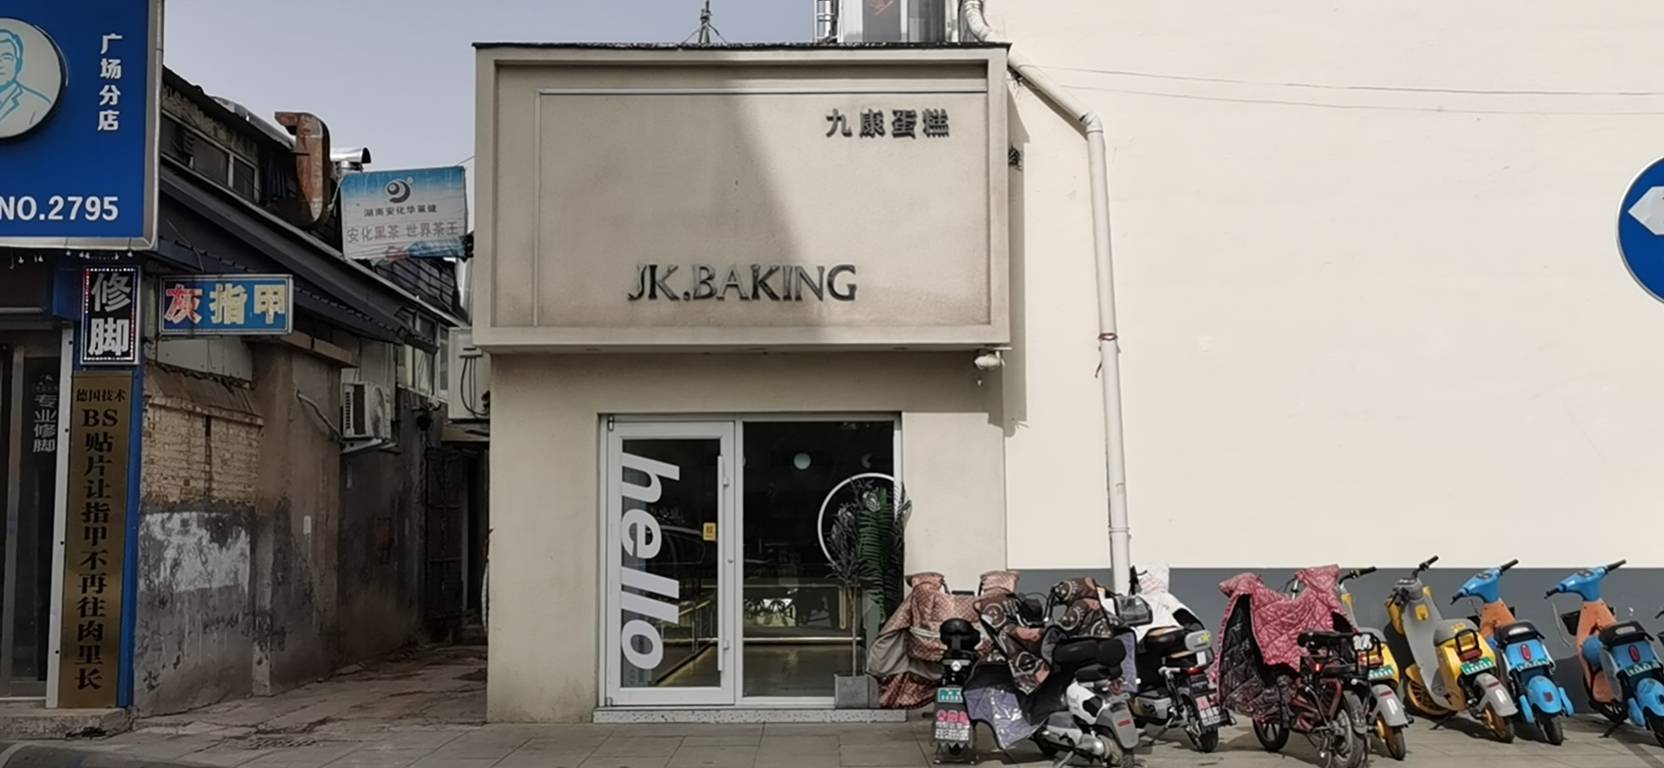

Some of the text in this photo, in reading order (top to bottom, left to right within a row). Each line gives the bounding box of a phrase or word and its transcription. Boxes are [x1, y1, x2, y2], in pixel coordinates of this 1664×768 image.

[98, 33, 122, 131] 广场分店
[826, 108, 949, 138] 九康蛋糕
[0, 195, 119, 221] NO.2795
[346, 220, 459, 243] 安化黑茶 世界茶王
[627, 264, 857, 302] JK.BAKING
[88, 272, 131, 356] 修脚
[164, 282, 286, 325] 灰指甲
[76, 388, 126, 402] 德国技术
[33, 394, 58, 453] 专业修脚
[621, 452, 680, 670] hello
